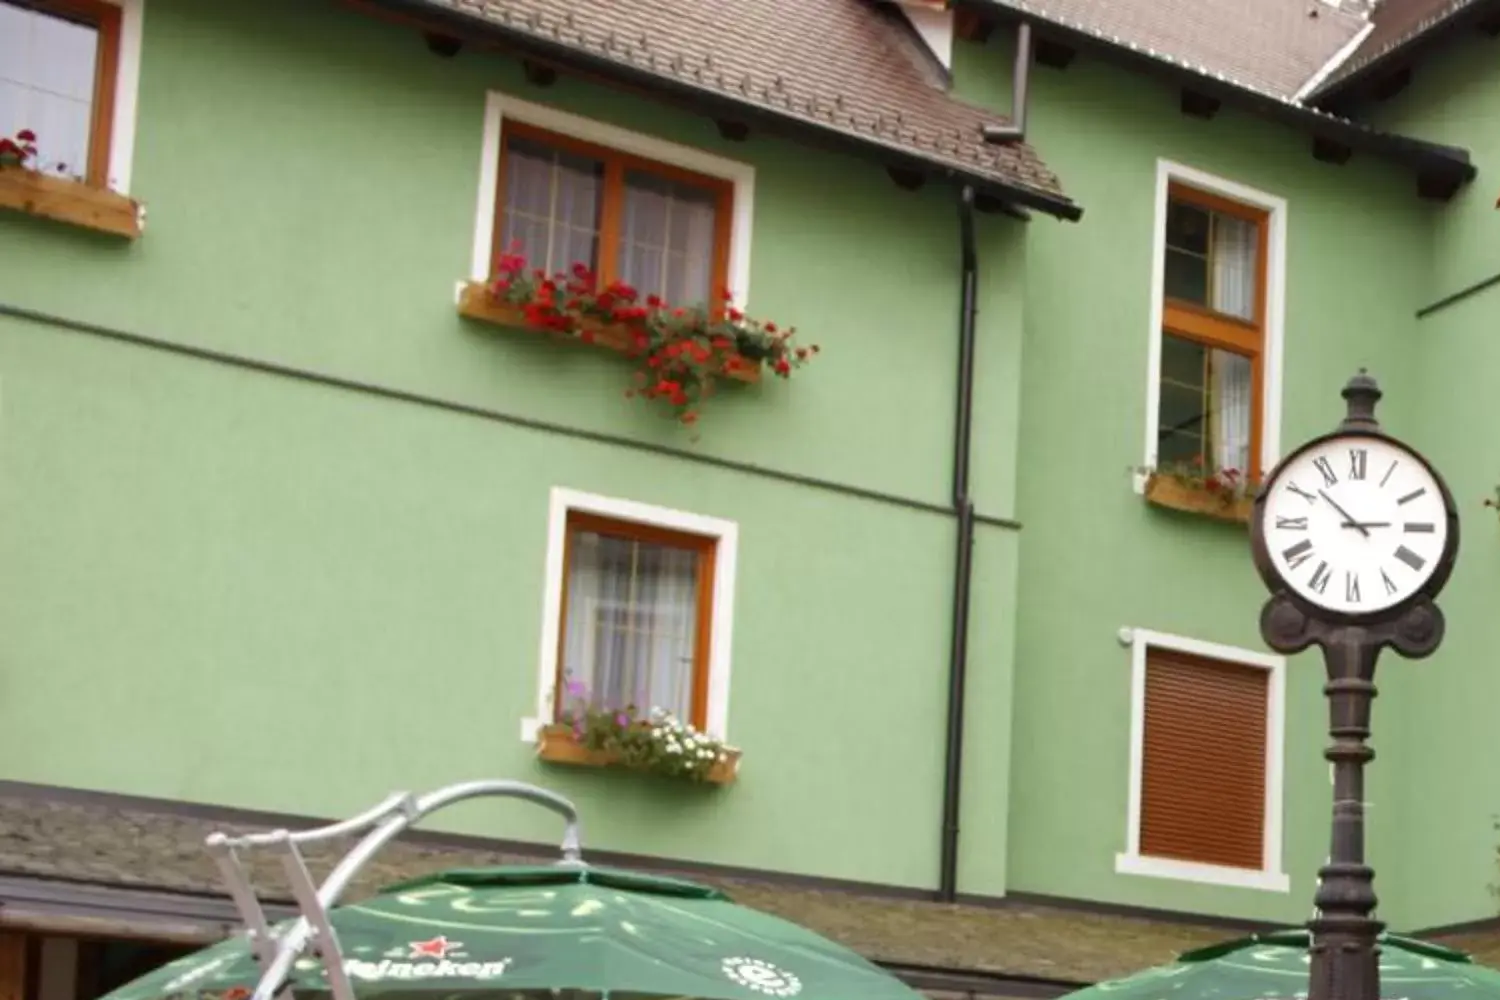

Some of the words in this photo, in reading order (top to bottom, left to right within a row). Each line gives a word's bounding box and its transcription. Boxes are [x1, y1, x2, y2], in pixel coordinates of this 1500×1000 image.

[1313, 455, 1338, 488] XI
[1349, 449, 1367, 480] XII
[1286, 481, 1317, 505] X
[1276, 515, 1309, 531] IX
[1345, 570, 1361, 602] VI
[1379, 566, 1399, 596] V
